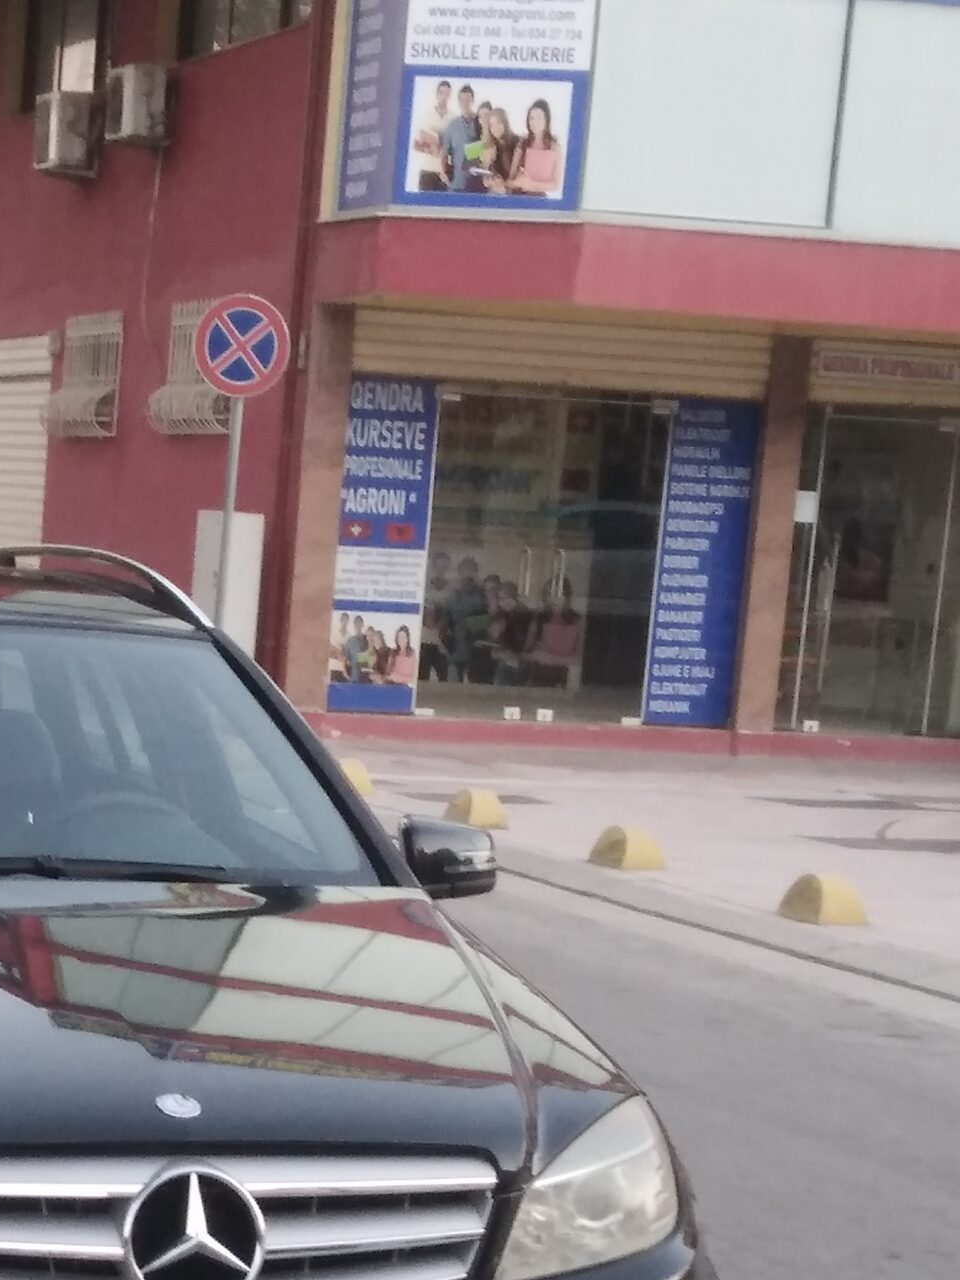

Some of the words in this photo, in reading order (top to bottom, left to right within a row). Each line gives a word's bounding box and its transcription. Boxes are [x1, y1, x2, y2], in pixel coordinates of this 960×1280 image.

[410, 42, 480, 60] SHKOLLE
[488, 45, 576, 63] PARUKERIE
[350, 380, 425, 413] QENDRA
[345, 417, 428, 450] KURSEVE
[343, 454, 424, 480] PROFESIONALE
